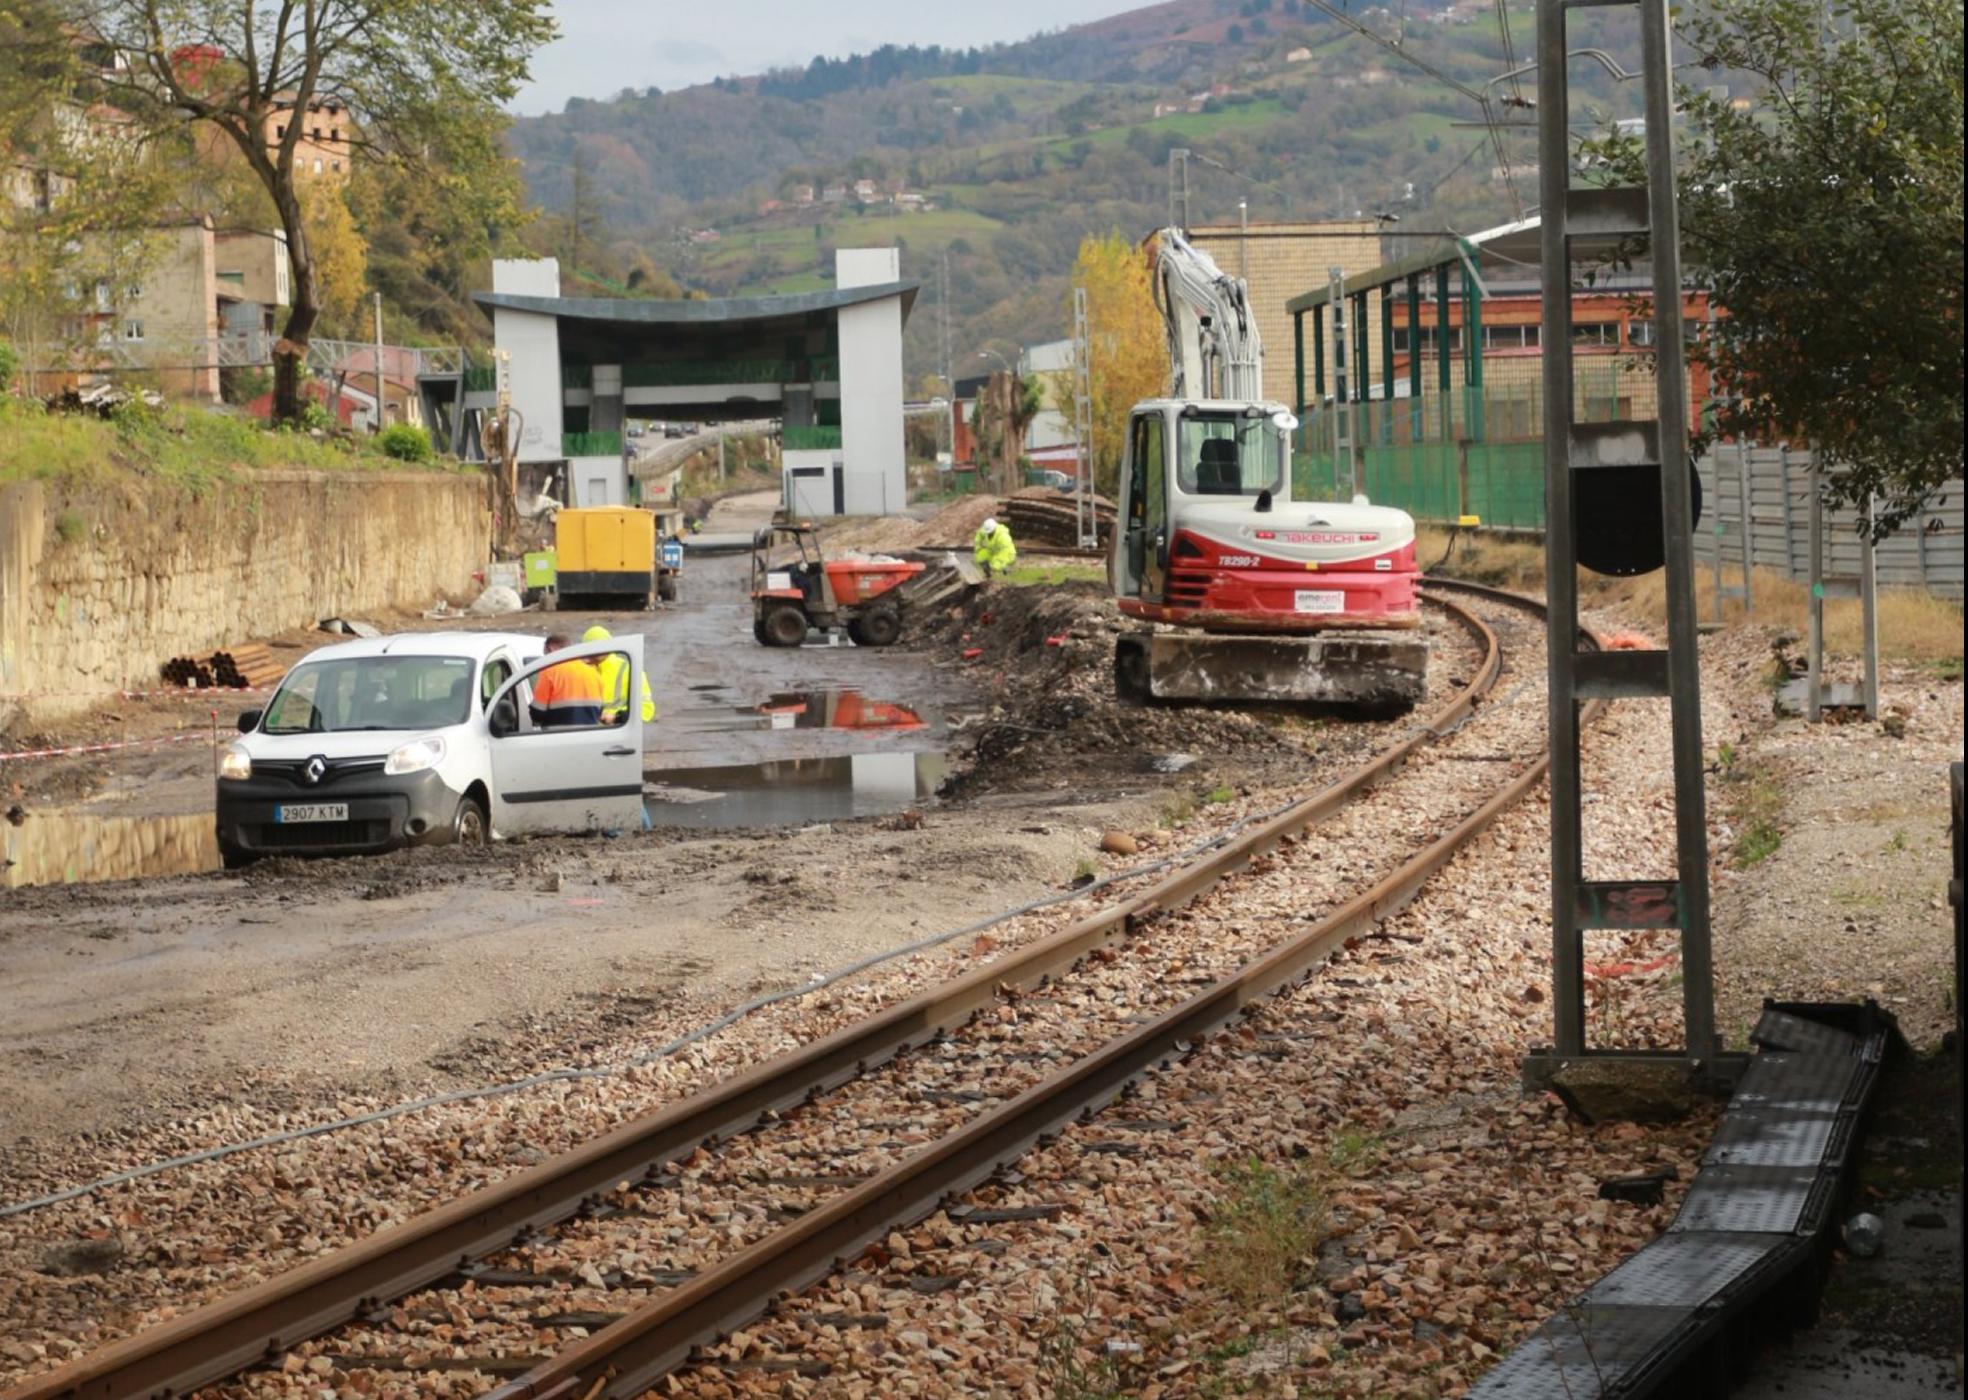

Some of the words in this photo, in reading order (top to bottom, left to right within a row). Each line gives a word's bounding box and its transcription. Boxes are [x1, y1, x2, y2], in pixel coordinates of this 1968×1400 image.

[1284, 533, 1355, 544] TAKEUCHI
[283, 807, 315, 820] 2907
[319, 805, 345, 819] KTM
